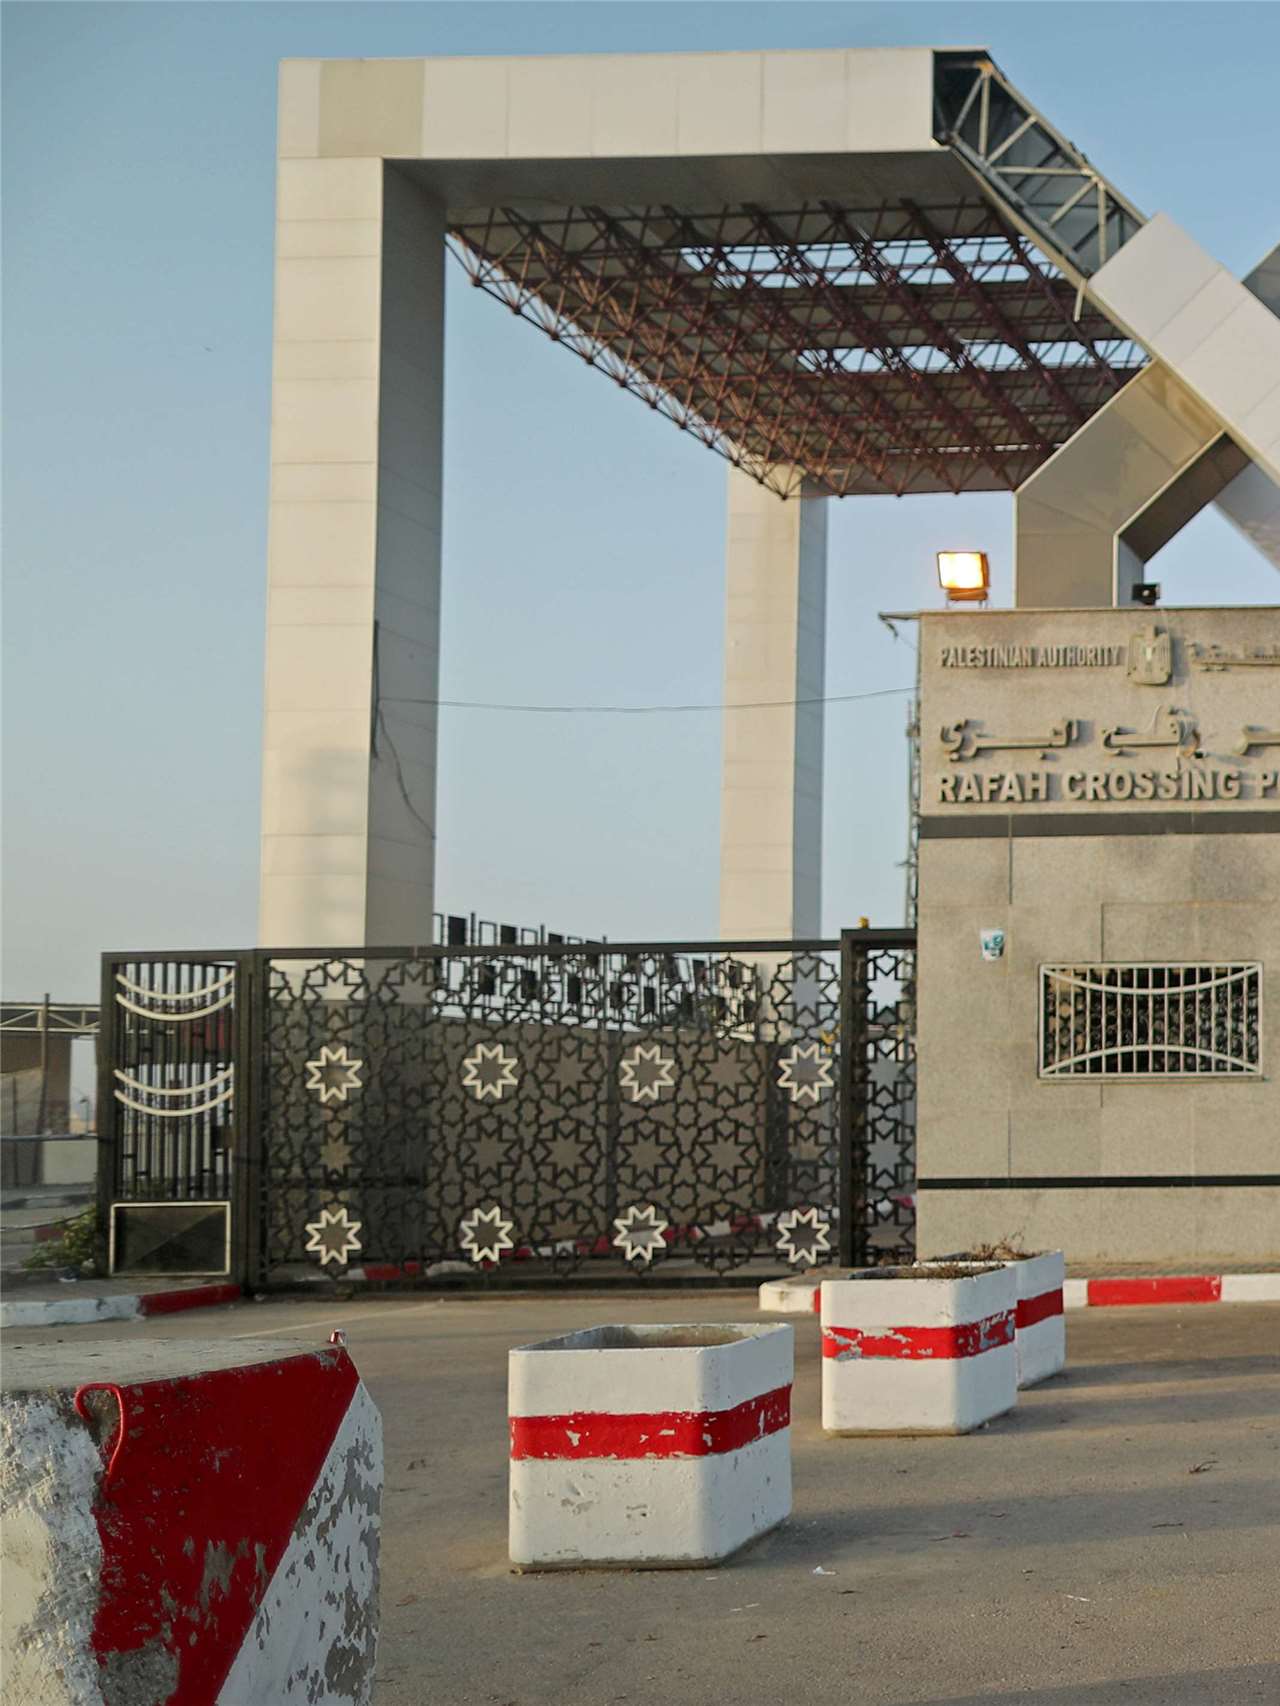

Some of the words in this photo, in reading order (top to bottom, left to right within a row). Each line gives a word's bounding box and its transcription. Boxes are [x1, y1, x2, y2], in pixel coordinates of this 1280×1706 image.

[941, 647, 1032, 668] PALESTINIAN
[1038, 646, 1120, 667] AUTHORITY
[940, 718, 1079, 762] البري
[939, 772, 1049, 802] RAFAH
[1060, 769, 1241, 801] CROSSING
